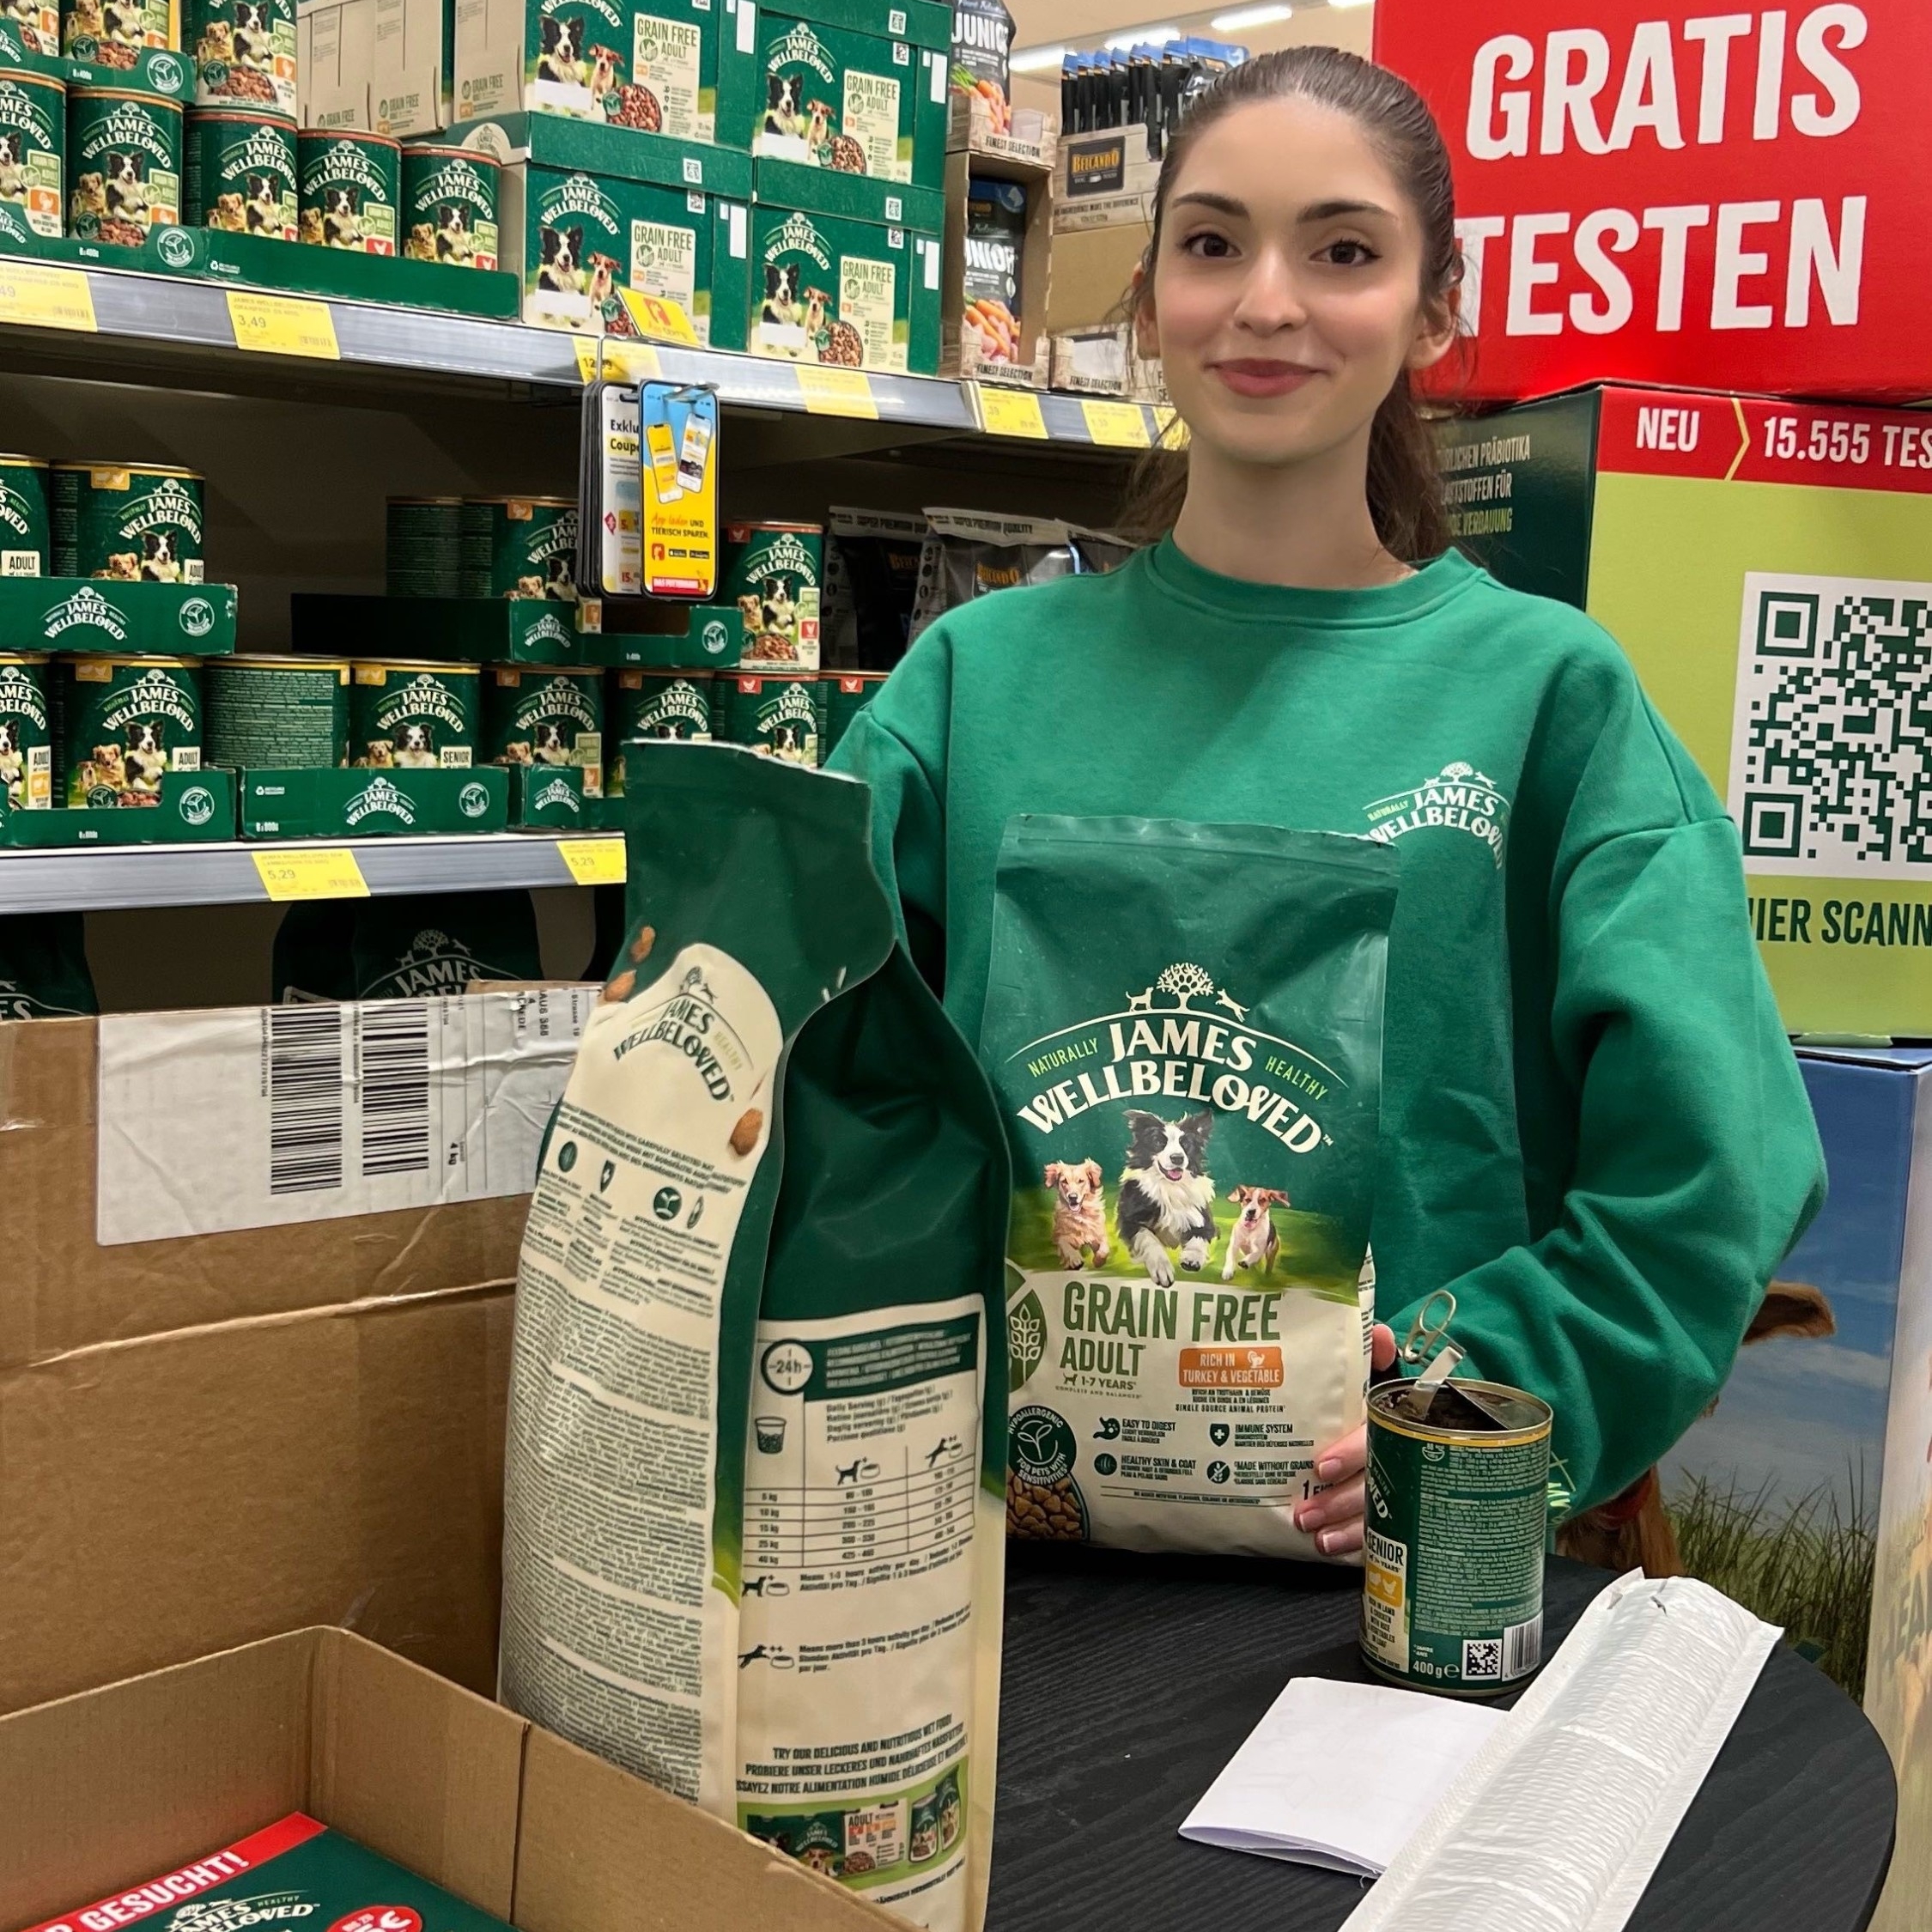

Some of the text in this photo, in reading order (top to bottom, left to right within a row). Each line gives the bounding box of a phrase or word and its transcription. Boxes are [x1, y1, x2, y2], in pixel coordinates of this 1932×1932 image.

[637, 18, 699, 47] GRAIN FREE
[951, 12, 1009, 57] JUNIO
[660, 41, 688, 58] ADULT
[786, 37, 820, 56] JAMES
[768, 50, 834, 84] WELLBELOVED
[846, 75, 898, 100] GRAIN FREE
[1466, 3, 1868, 161] GRATIS
[866, 97, 890, 112] ADULT
[107, 118, 155, 137] JAMES
[82, 131, 173, 168] WELLBELOVED
[246, 141, 287, 161] JAMES
[324, 155, 370, 173] JAMES
[303, 167, 387, 202] WELLBELOVED
[438, 173, 481, 192] JAMES
[415, 185, 495, 220] WELLBELOVED
[562, 186, 602, 206] JAMES
[541, 200, 619, 236] WELLBELOVED
[634, 224, 694, 252] GRAIN FREE
[782, 226, 817, 244] JAMES
[657, 247, 683, 264] ADULT
[764, 238, 830, 271] WELLBELOVED
[1453, 195, 1868, 337] TESTEN
[841, 260, 894, 284] GRAIN FREE
[861, 282, 884, 297] ADULT
[237, 314, 267, 329] 3,49
[1636, 407, 1700, 453] NEU
[1763, 416, 1870, 465] 15.555
[1479, 434, 1531, 466] PRÄBIOTIKA
[1495, 468, 1513, 499] FÜR
[148, 496, 191, 515] JAMES
[118, 510, 203, 544] WELLBELOVED
[551, 525, 578, 540] JAM
[527, 538, 578, 564] WELLBE
[769, 547, 805, 562] JAMES
[9, 555, 35, 571] ADULT
[67, 601, 108, 617] JAMES
[44, 612, 125, 641] WELLBELOVED
[0, 684, 33, 702] AMES
[131, 686, 179, 704] JAMES
[401, 690, 449, 707] JAMES
[539, 691, 582, 707] JAMES
[660, 693, 698, 709] JAMES
[778, 697, 811, 712] JAMES
[0, 698, 46, 731] BELOVED
[101, 700, 196, 732] WELLBELOVED
[376, 702, 465, 733] WELLBELOVED
[515, 703, 596, 732] WELLBELOVED
[178, 750, 198, 766] ADULT
[442, 750, 471, 764] SENIOR
[362, 789, 398, 804] JAMES
[1413, 786, 1499, 817] JAMES
[345, 800, 415, 826] WELLBELOVED
[1367, 799, 1409, 822] NATURALLY
[267, 868, 297, 881] 5,29
[1820, 899, 1932, 947] SCANN
[659, 997, 715, 1036] JAMES
[1109, 1018, 1257, 1072] JAMES
[613, 1018, 731, 1102] WELLBELOVED
[1028, 1037, 1329, 1102] NATURALLY HEALTHY
[1017, 1060, 1323, 1154] WELLBELOVED
[1062, 1280, 1284, 1342] GRAIN FREE
[1060, 1335, 1146, 1377] ADULT
[1200, 1351, 1236, 1369] RICH IN
[1081, 1375, 1097, 1387] 1-7
[1182, 1368, 1281, 1385] TURKEY & VEGETABLE
[1175, 1403, 1200, 1413] SINGLE
[1200, 1404, 1228, 1413] SOURCE
[1228, 1405, 1255, 1413] ANIMAL
[1007, 1406, 1064, 1435] HYPOALLERGENIC
[1121, 1418, 1176, 1432] EASY TO DIGEST
[1235, 1423, 1293, 1434] IMMUNE SYSTEM
[1016, 1451, 1066, 1476] FOR PETS WITH
[1121, 1454, 1197, 1470] HEALTHY SKIN & COAT
[1258, 1461, 1290, 1471] WITHOUT
[1290, 1460, 1315, 1470] GRAINS
[1413, 1660, 1435, 1676] 400
[772, 1747, 791, 1760] TRY
[793, 1747, 811, 1759] OUR
[813, 1742, 860, 1759] DELICIOUS
[860, 1740, 879, 1753] AND
[879, 1727, 923, 1752] NUTRITIOUS
[744, 1763, 790, 1777] PROBIERE
[792, 1763, 823, 1777] UNSER
[823, 1759, 868, 1775] LECKERES
[869, 1756, 888, 1770] UND
[736, 1779, 770, 1795] SSAYEZ
[771, 1781, 801, 1795] NOTRE
[802, 1777, 868, 1795] ALIMENTATION
[868, 1771, 902, 1787] HUMIDE
[848, 1812, 874, 1827] ADULT
[78, 1850, 250, 1932] GESUCHT!
[257, 1894, 301, 1908] HEALTHY
